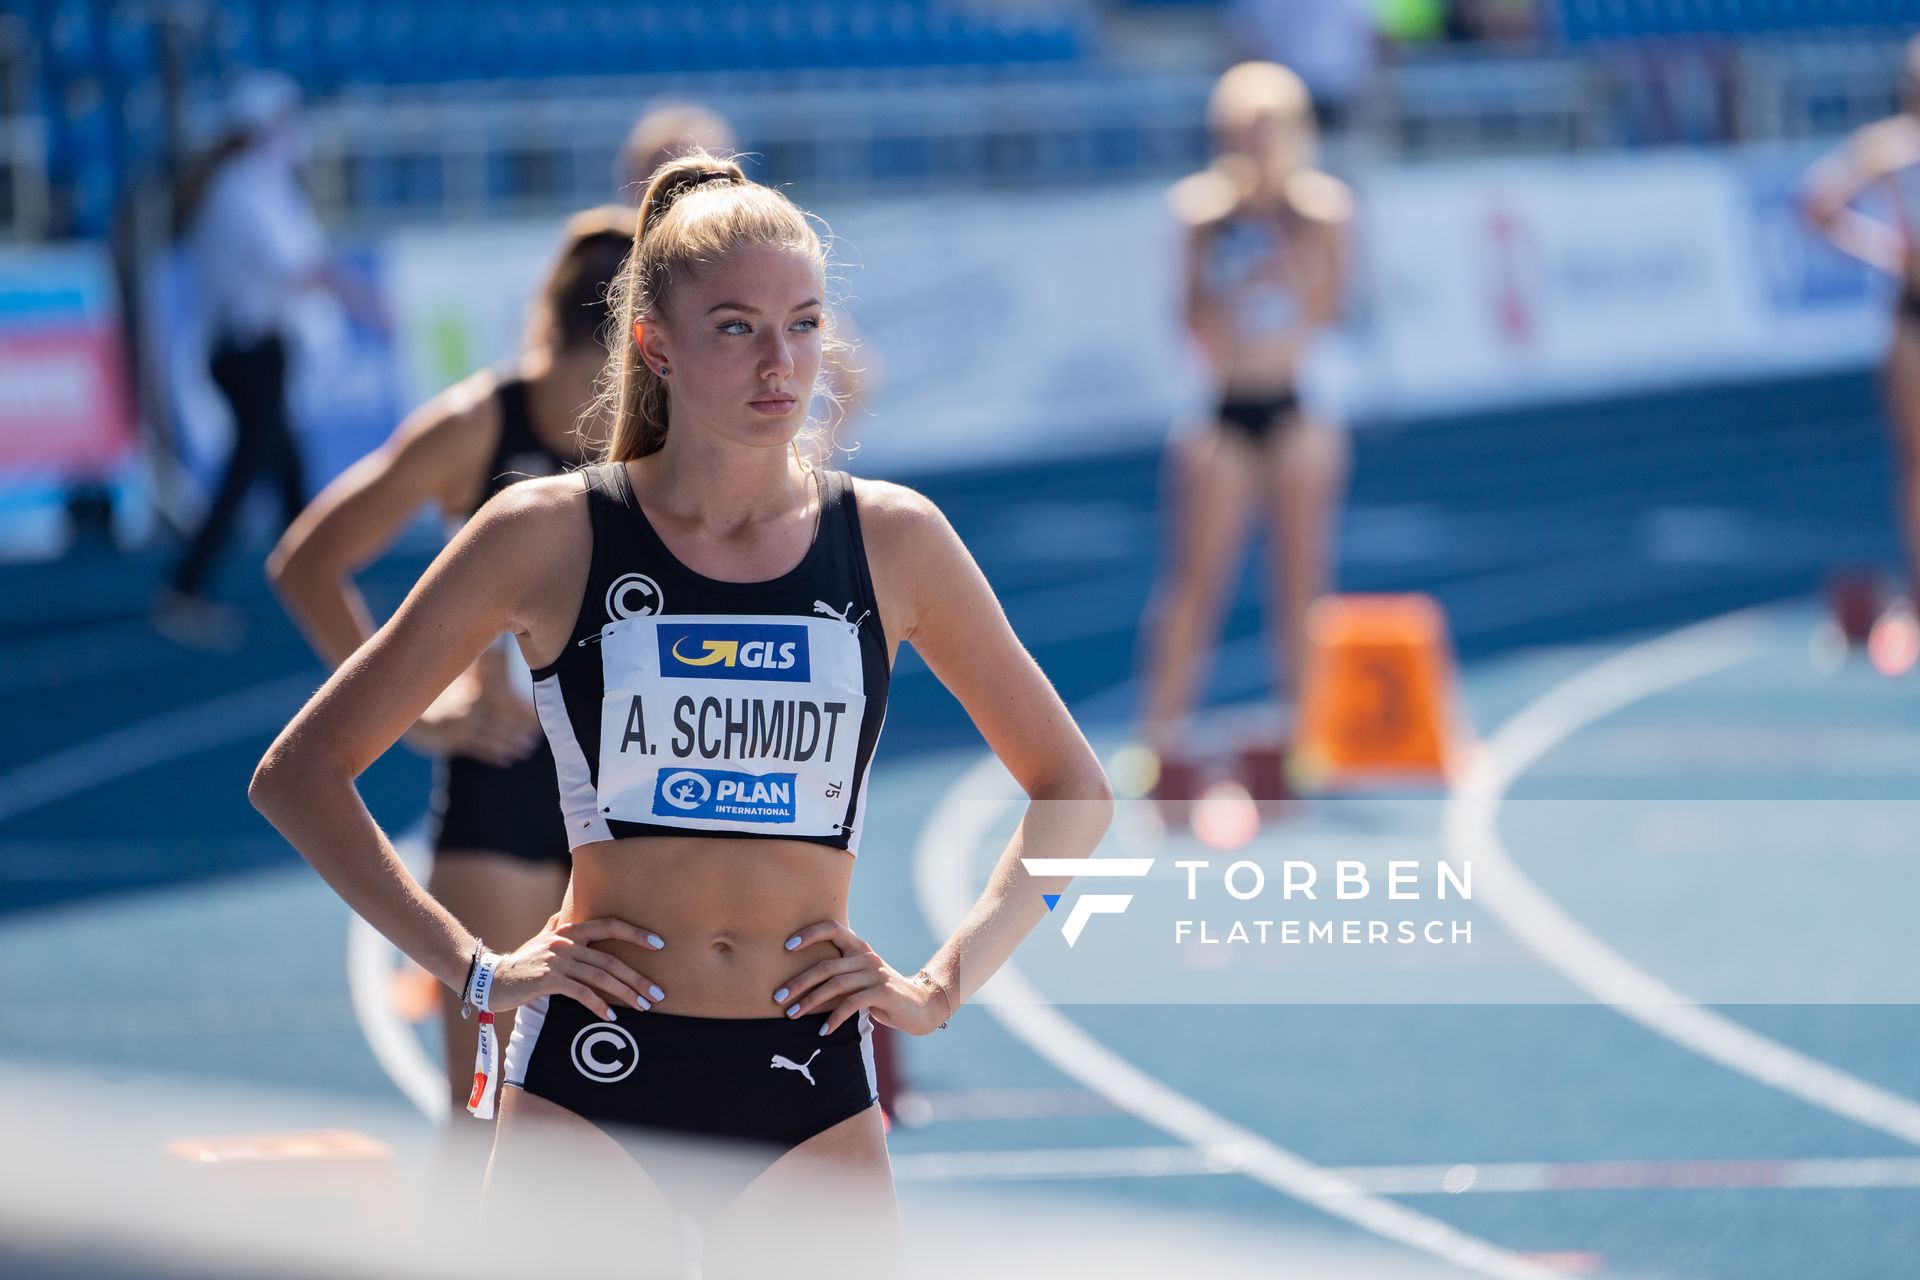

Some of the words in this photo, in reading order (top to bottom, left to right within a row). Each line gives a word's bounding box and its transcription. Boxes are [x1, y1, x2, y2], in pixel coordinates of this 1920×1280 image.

[740, 641, 795, 669] GLS
[620, 694, 656, 755] A.
[671, 695, 847, 762] SCHMIDT
[716, 780, 790, 804] PLAN
[825, 780, 843, 798] 75
[715, 805, 790, 816] INTERNATIONAL
[475, 957, 494, 1005] LEICHTA
